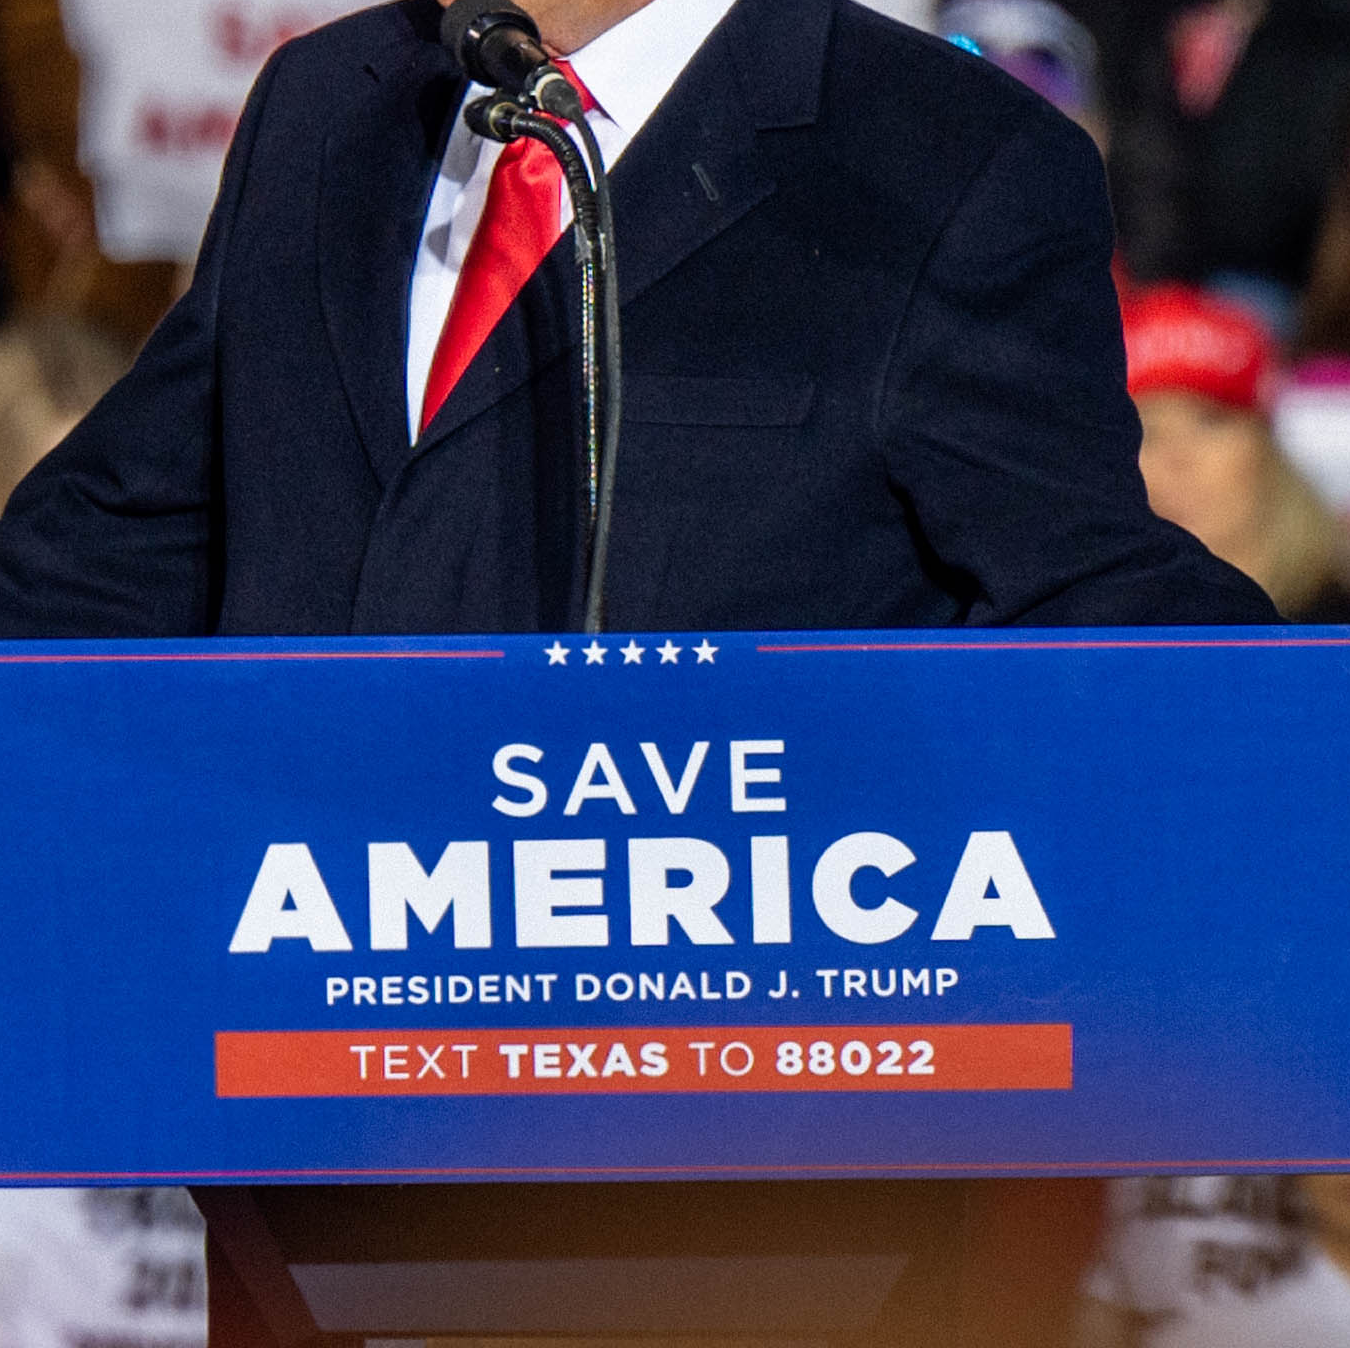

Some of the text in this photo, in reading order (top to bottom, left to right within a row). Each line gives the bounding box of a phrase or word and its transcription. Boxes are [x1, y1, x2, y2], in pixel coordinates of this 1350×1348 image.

[492, 739, 787, 817] SAVE
[228, 830, 1056, 953] AMERICA
[326, 968, 959, 1006] PRESIDENT DONALD J. TRUMP
[349, 1039, 935, 1080] TEXT TEXAS TO 88022
